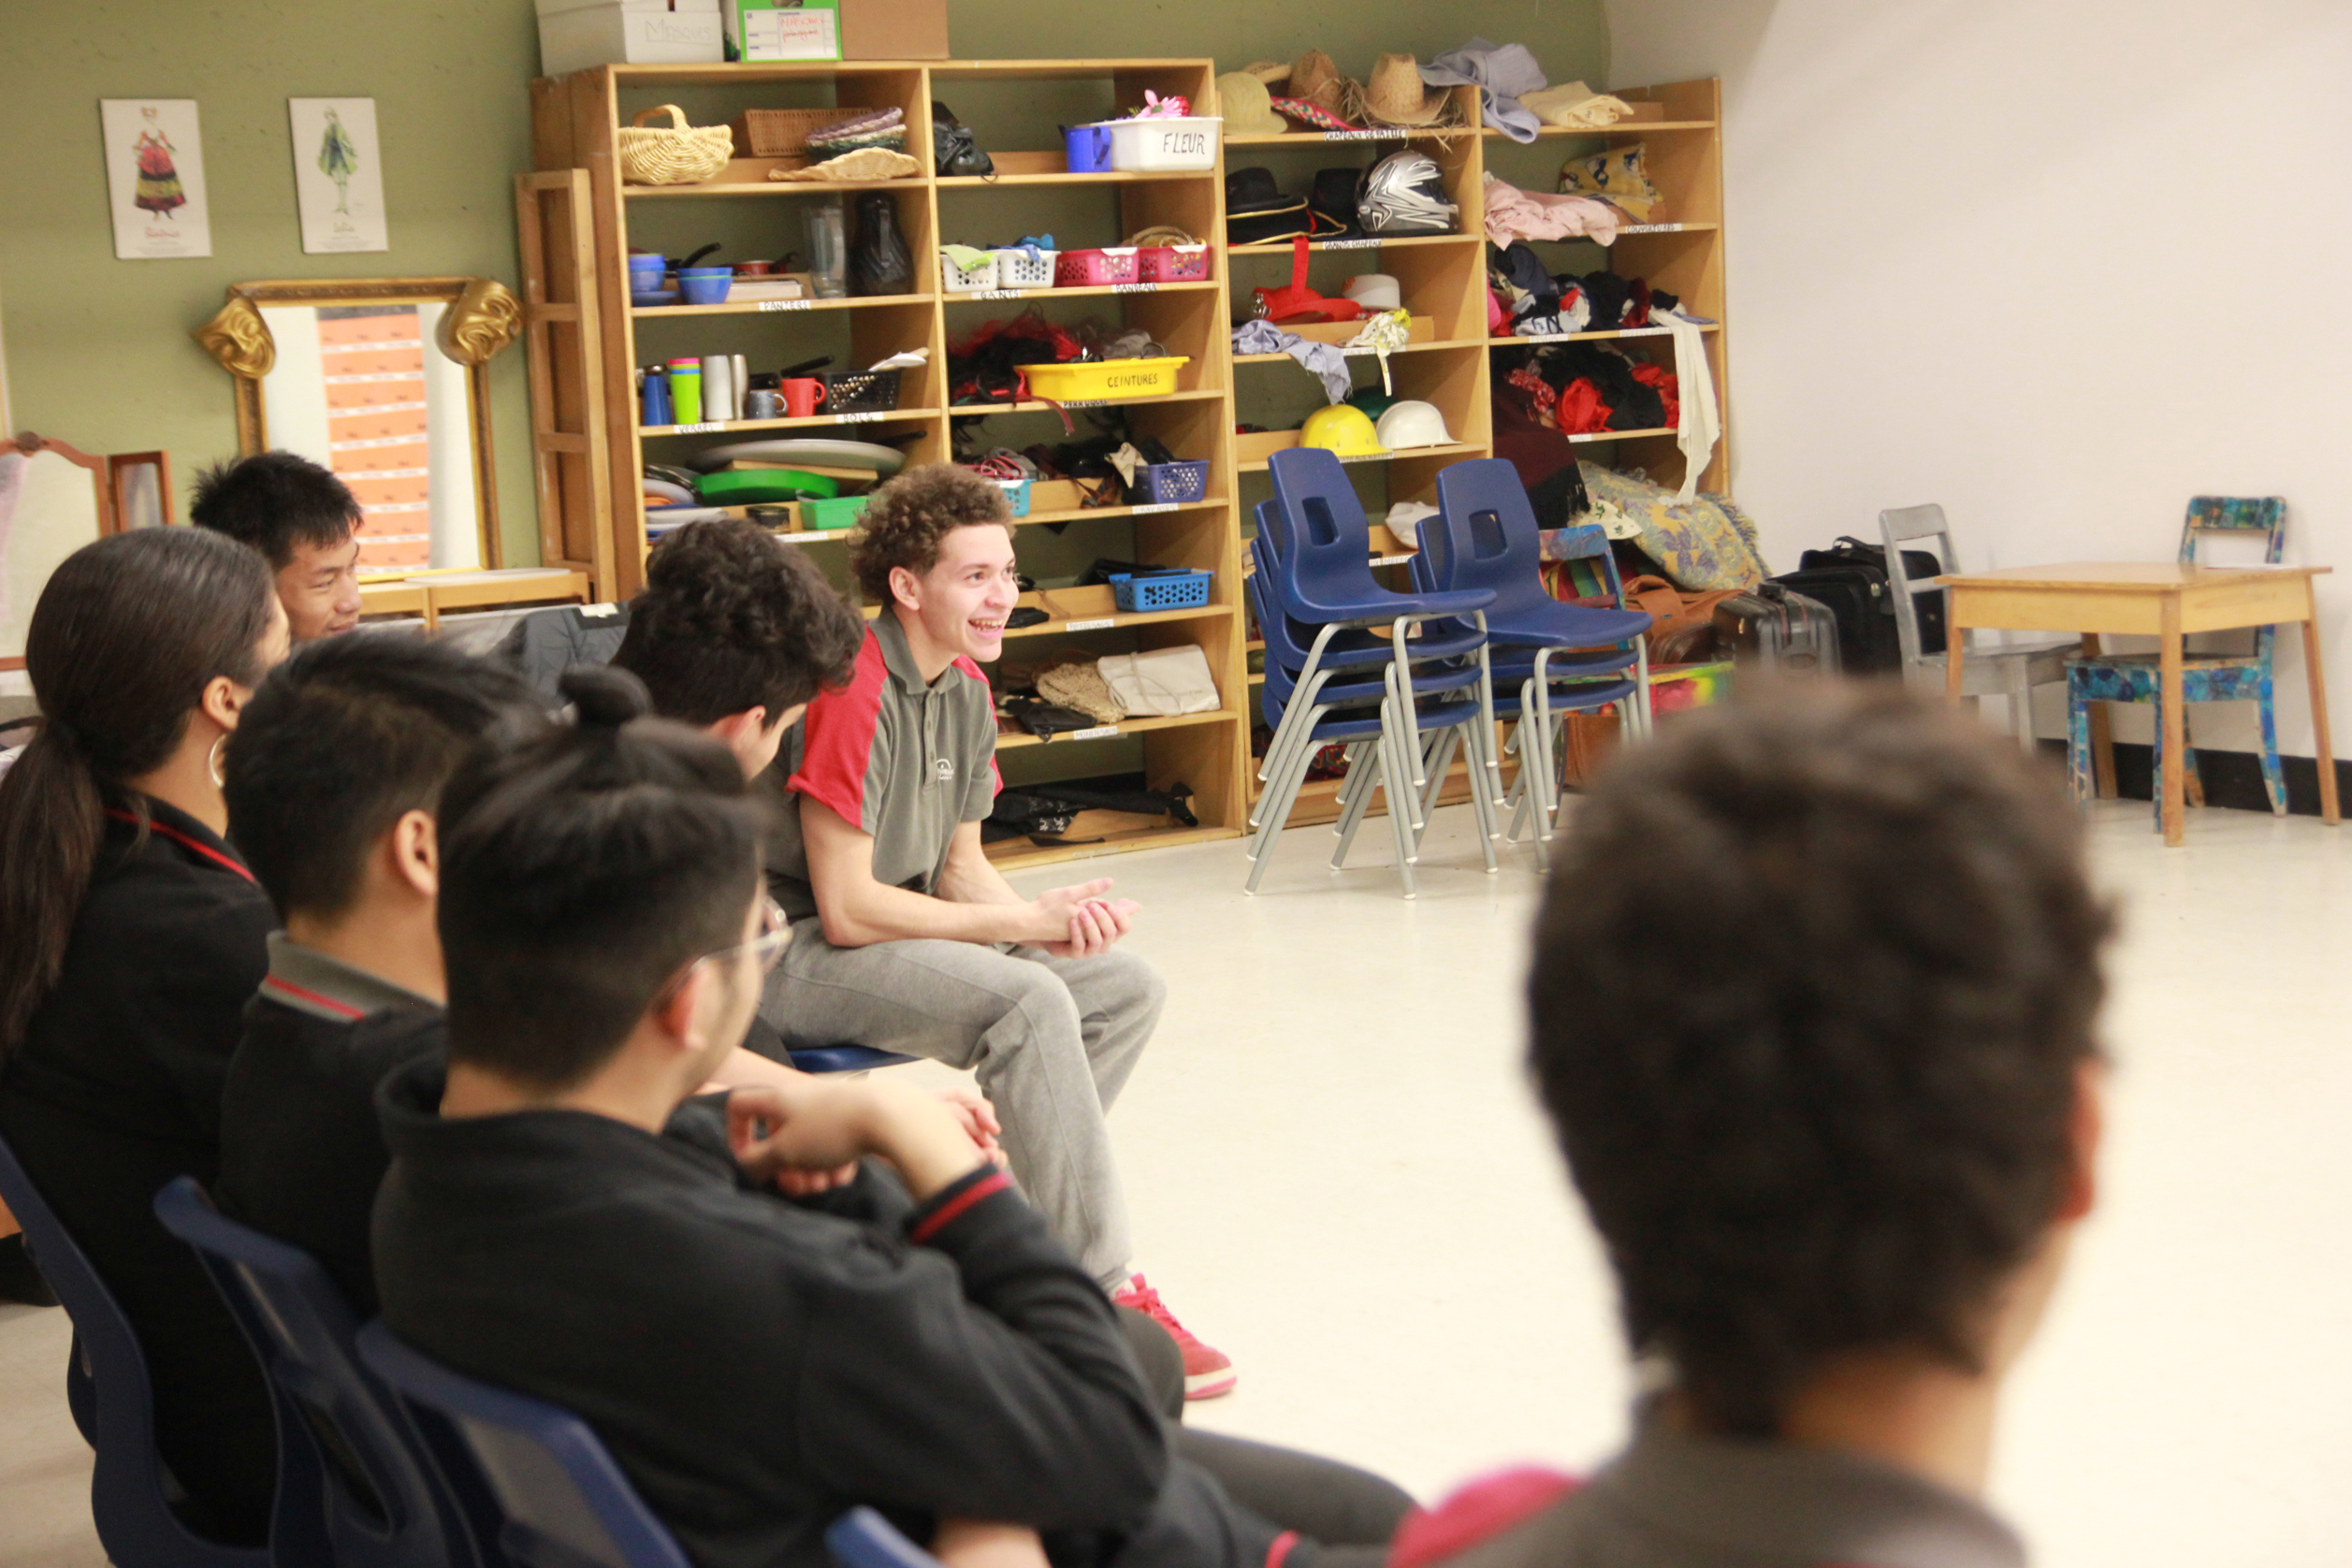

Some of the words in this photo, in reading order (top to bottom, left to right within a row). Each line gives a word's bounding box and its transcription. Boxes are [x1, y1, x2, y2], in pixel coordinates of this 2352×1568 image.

[1163, 132, 1205, 154] FLEUR
[980, 289, 1018, 299] GANTS
[1107, 372, 1158, 388] CEINTURES
[678, 423, 713, 433] VERRES
